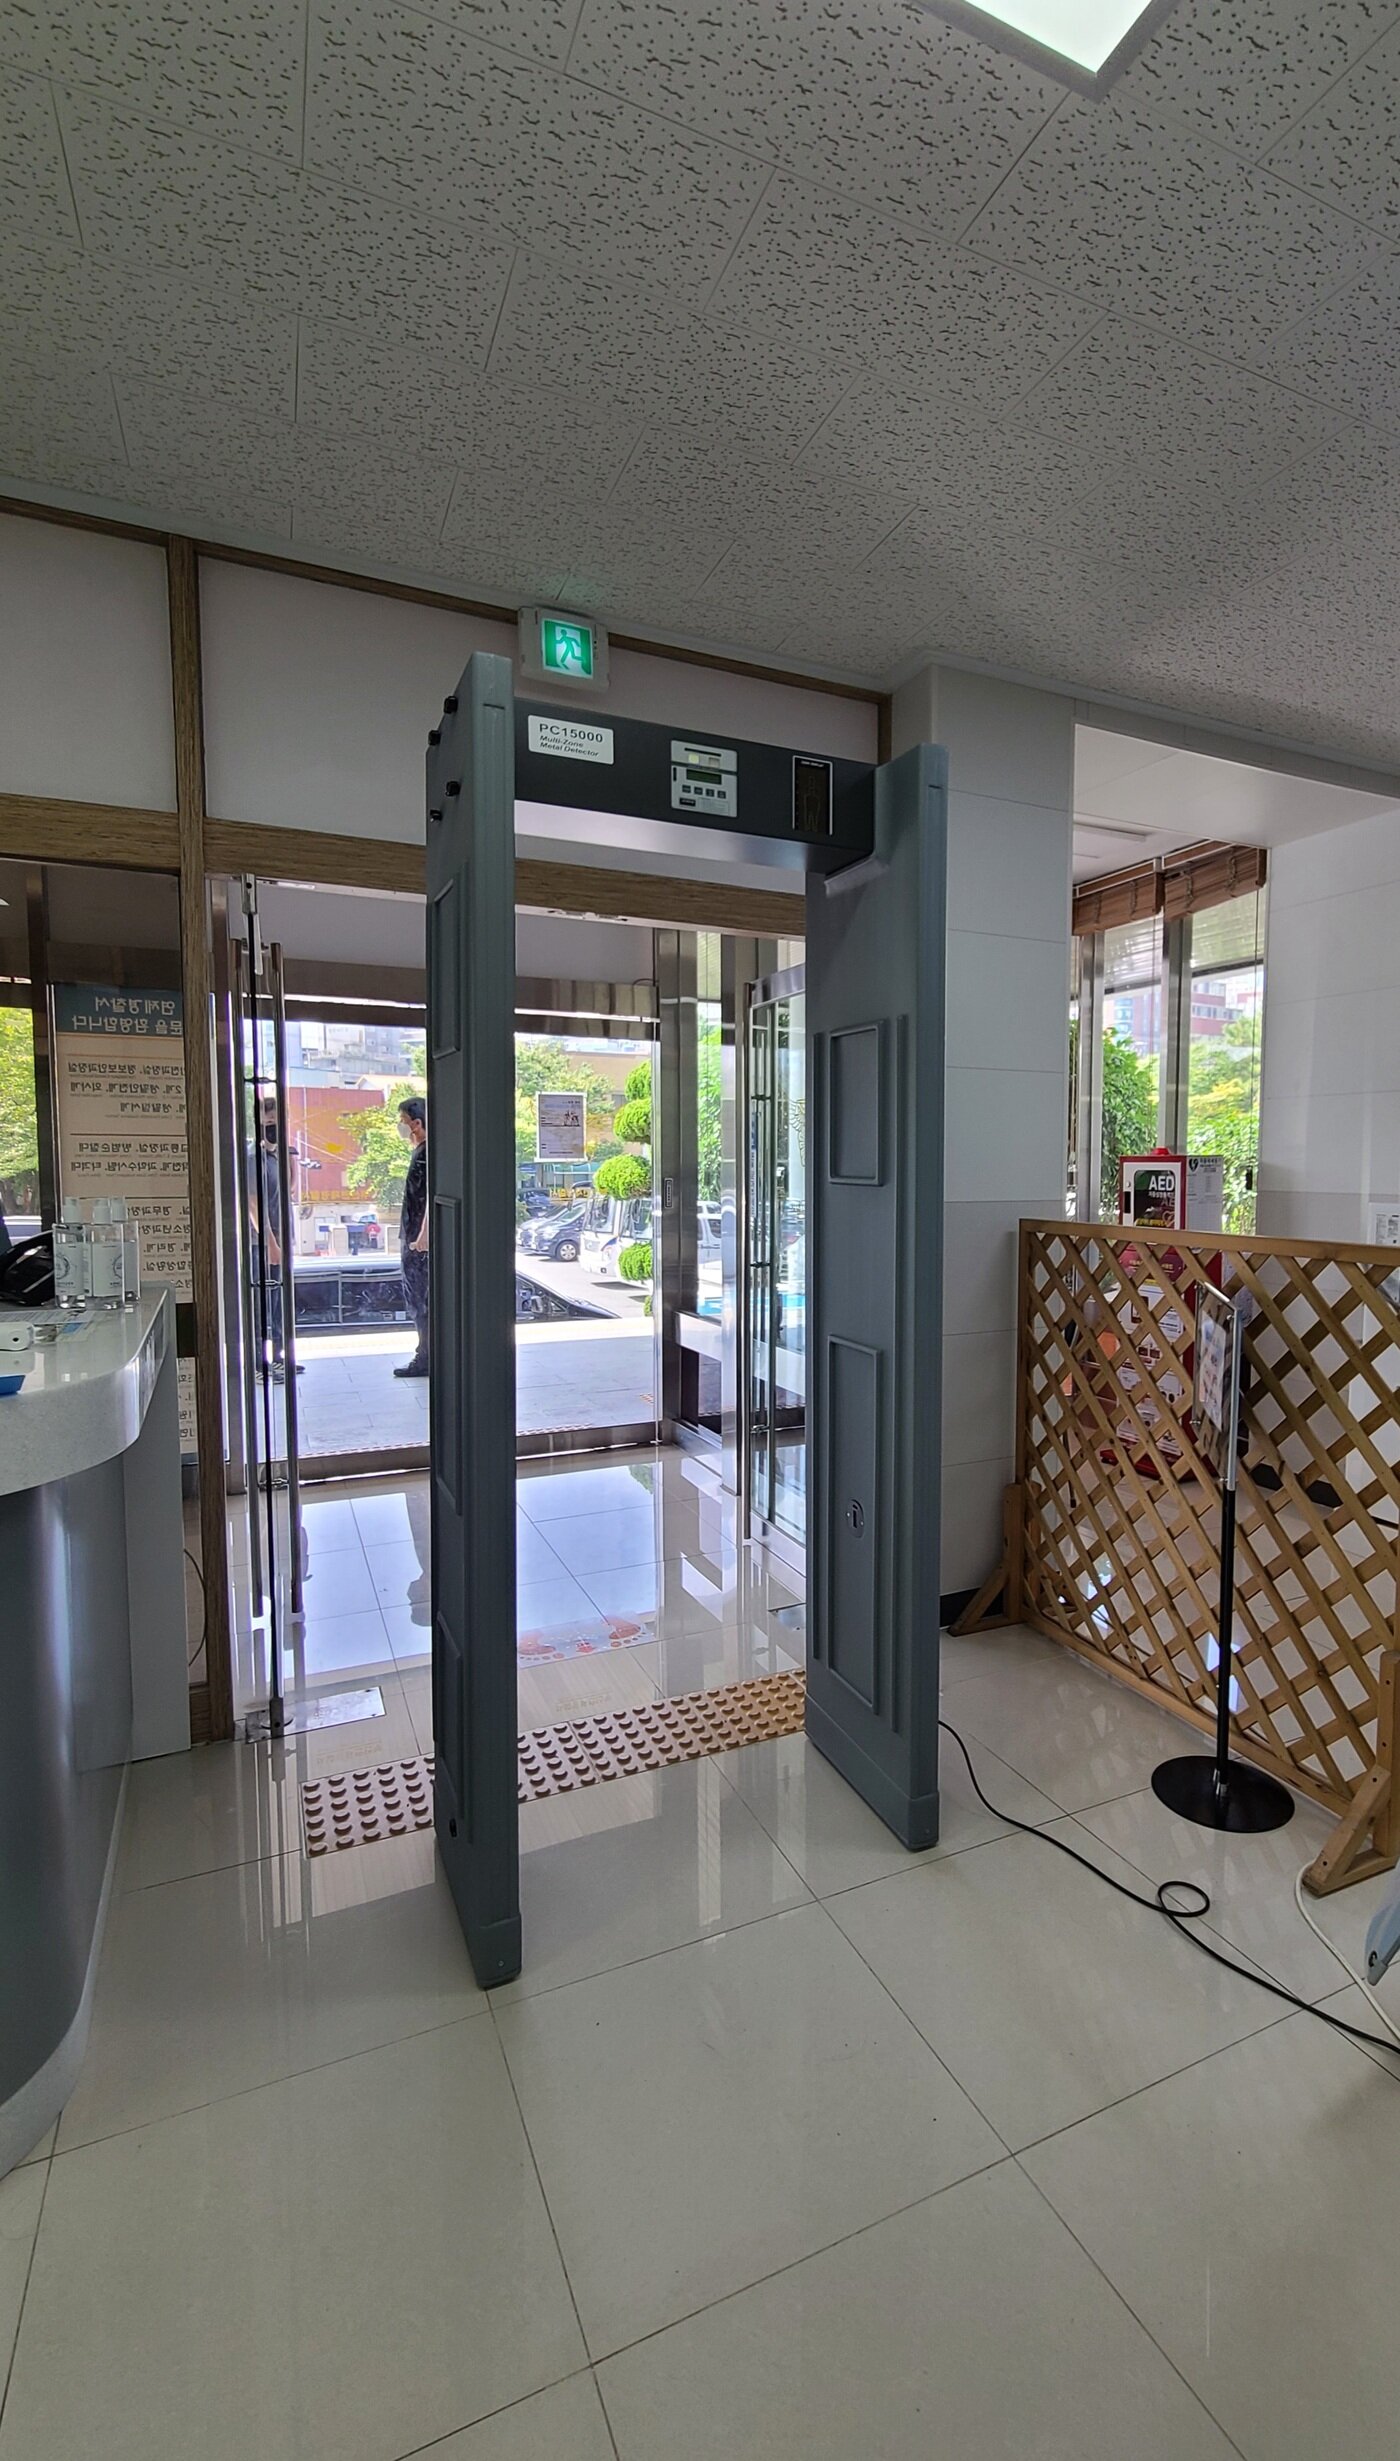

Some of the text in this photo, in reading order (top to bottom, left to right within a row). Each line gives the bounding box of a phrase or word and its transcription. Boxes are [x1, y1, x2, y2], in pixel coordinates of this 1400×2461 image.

[539, 723, 603, 743] PC15000
[540, 735, 584, 748] Multi-Zone
[540, 742, 599, 757] Metal Detector
[1149, 1175, 1175, 1191] AED
